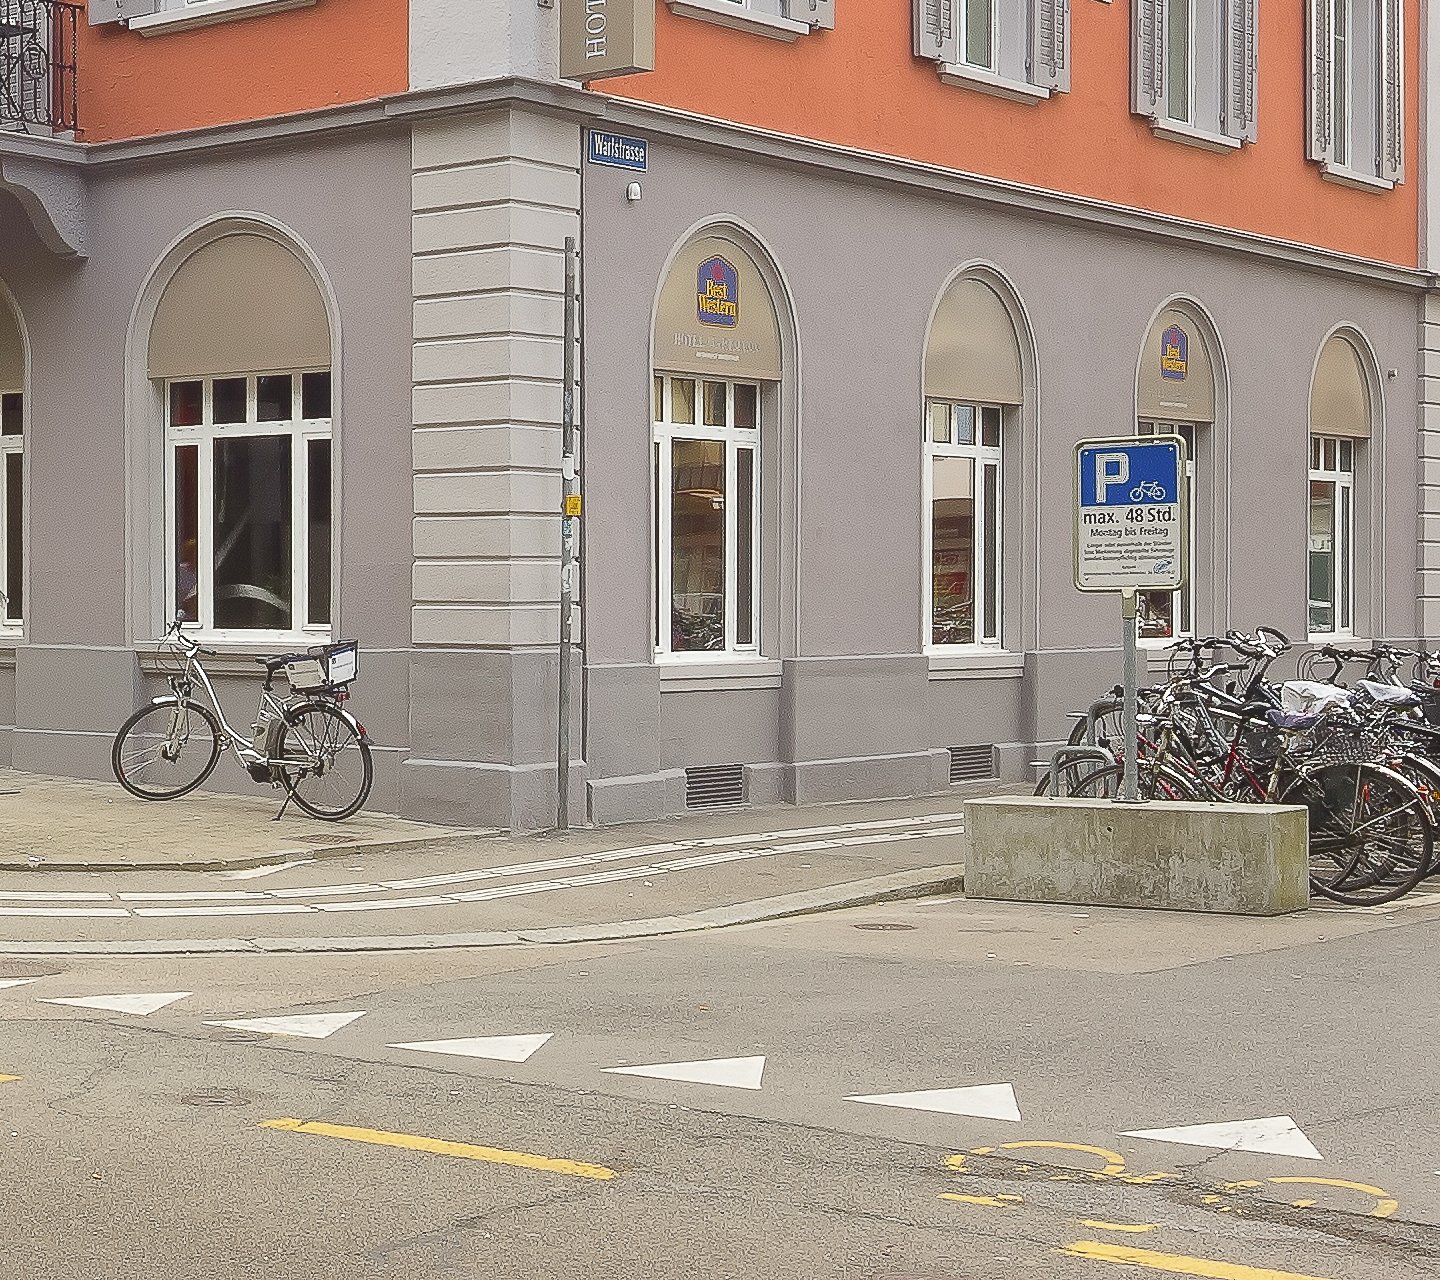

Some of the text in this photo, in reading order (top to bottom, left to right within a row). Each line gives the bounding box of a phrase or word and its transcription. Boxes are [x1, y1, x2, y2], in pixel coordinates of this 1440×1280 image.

[594, 133, 645, 162] Wartstrasse
[705, 279, 728, 299] Best
[1096, 452, 1130, 503] P
[1083, 505, 1176, 525] max. 48 Std.
[1090, 525, 1169, 539] Montag bis Freitag
